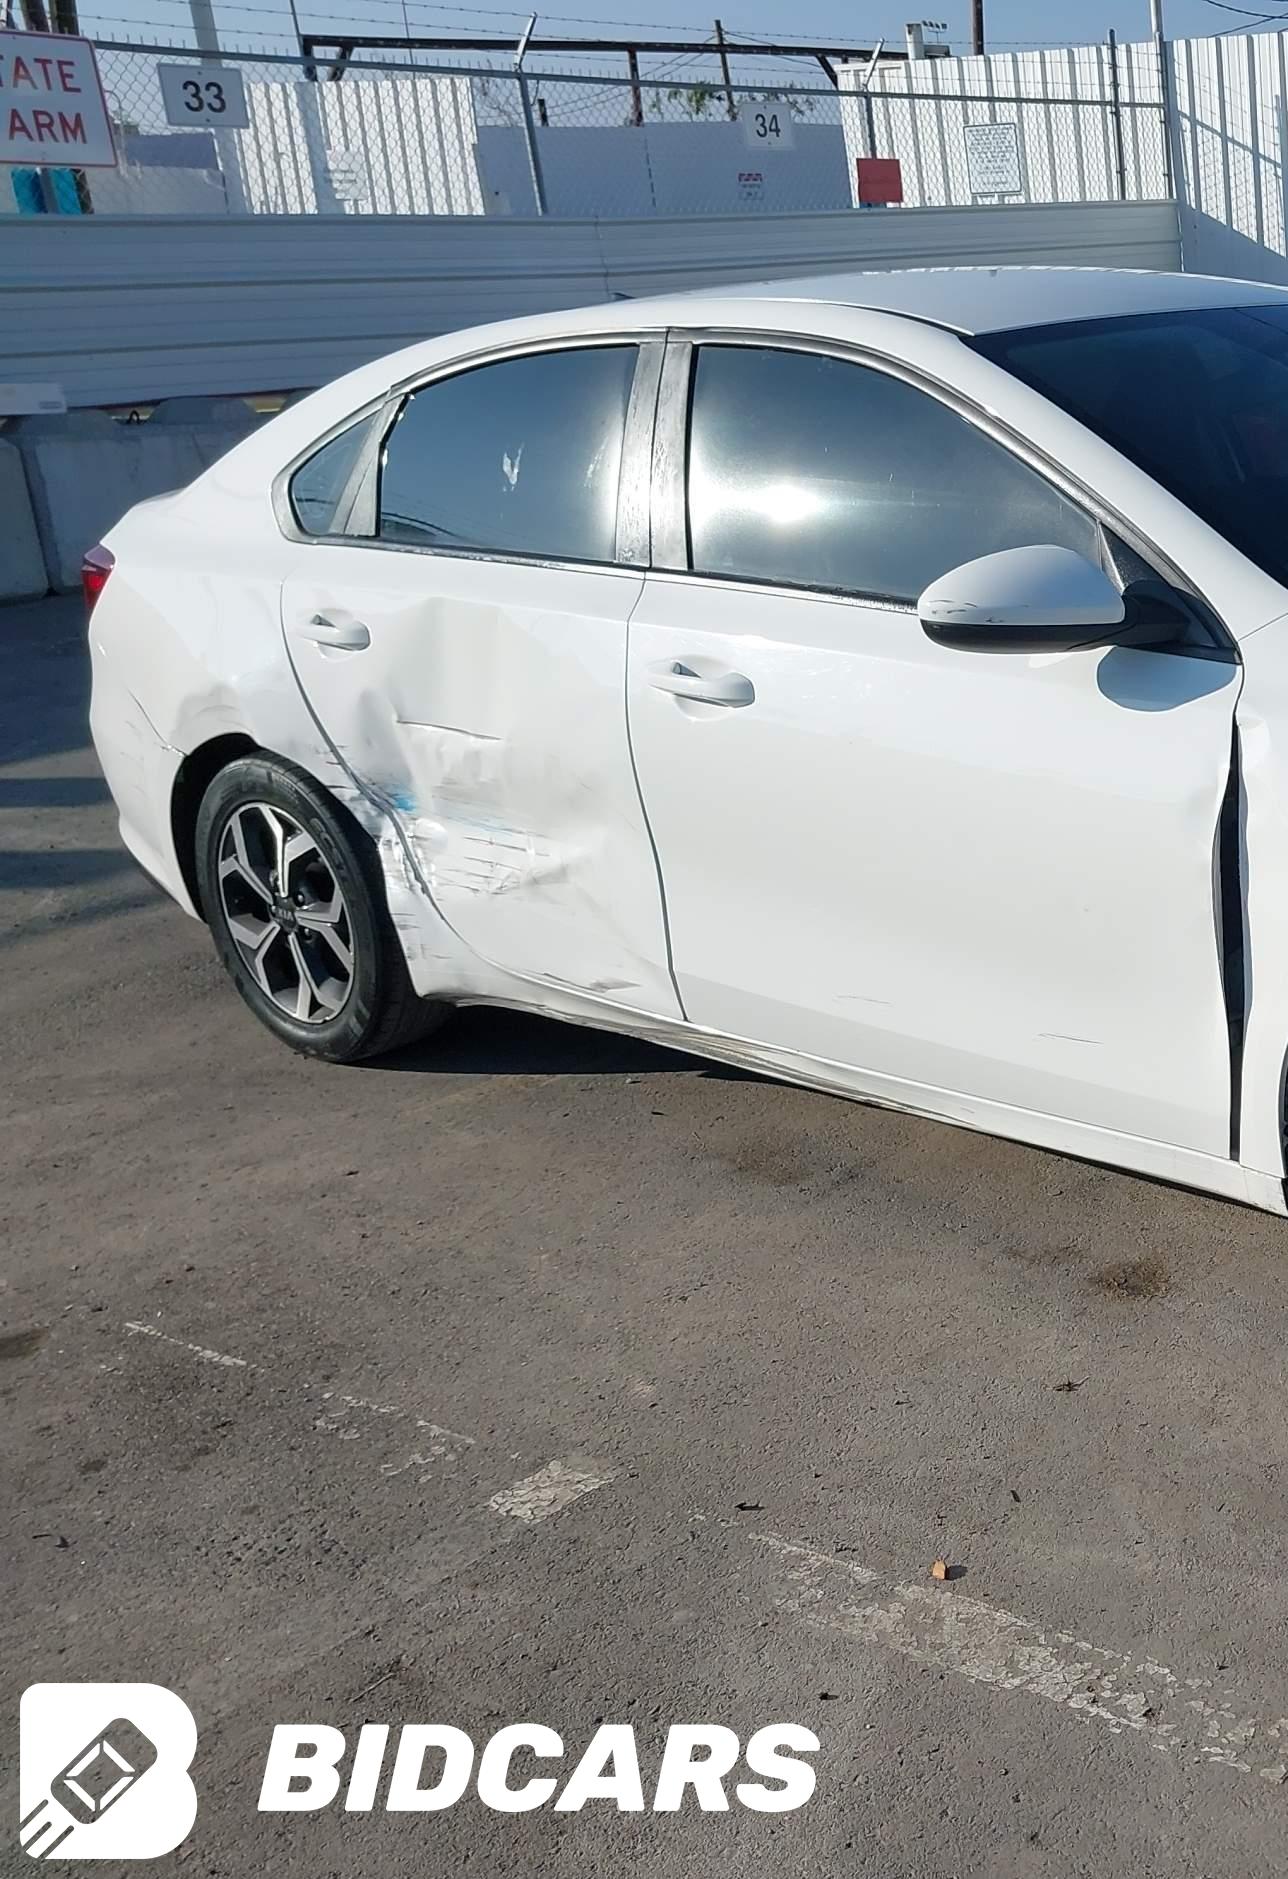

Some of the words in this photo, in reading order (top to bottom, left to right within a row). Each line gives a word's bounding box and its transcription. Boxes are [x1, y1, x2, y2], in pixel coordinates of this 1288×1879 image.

[0, 54, 81, 93] ATE
[182, 80, 227, 113] 33
[9, 108, 87, 145] ARM
[755, 113, 781, 138] 34
